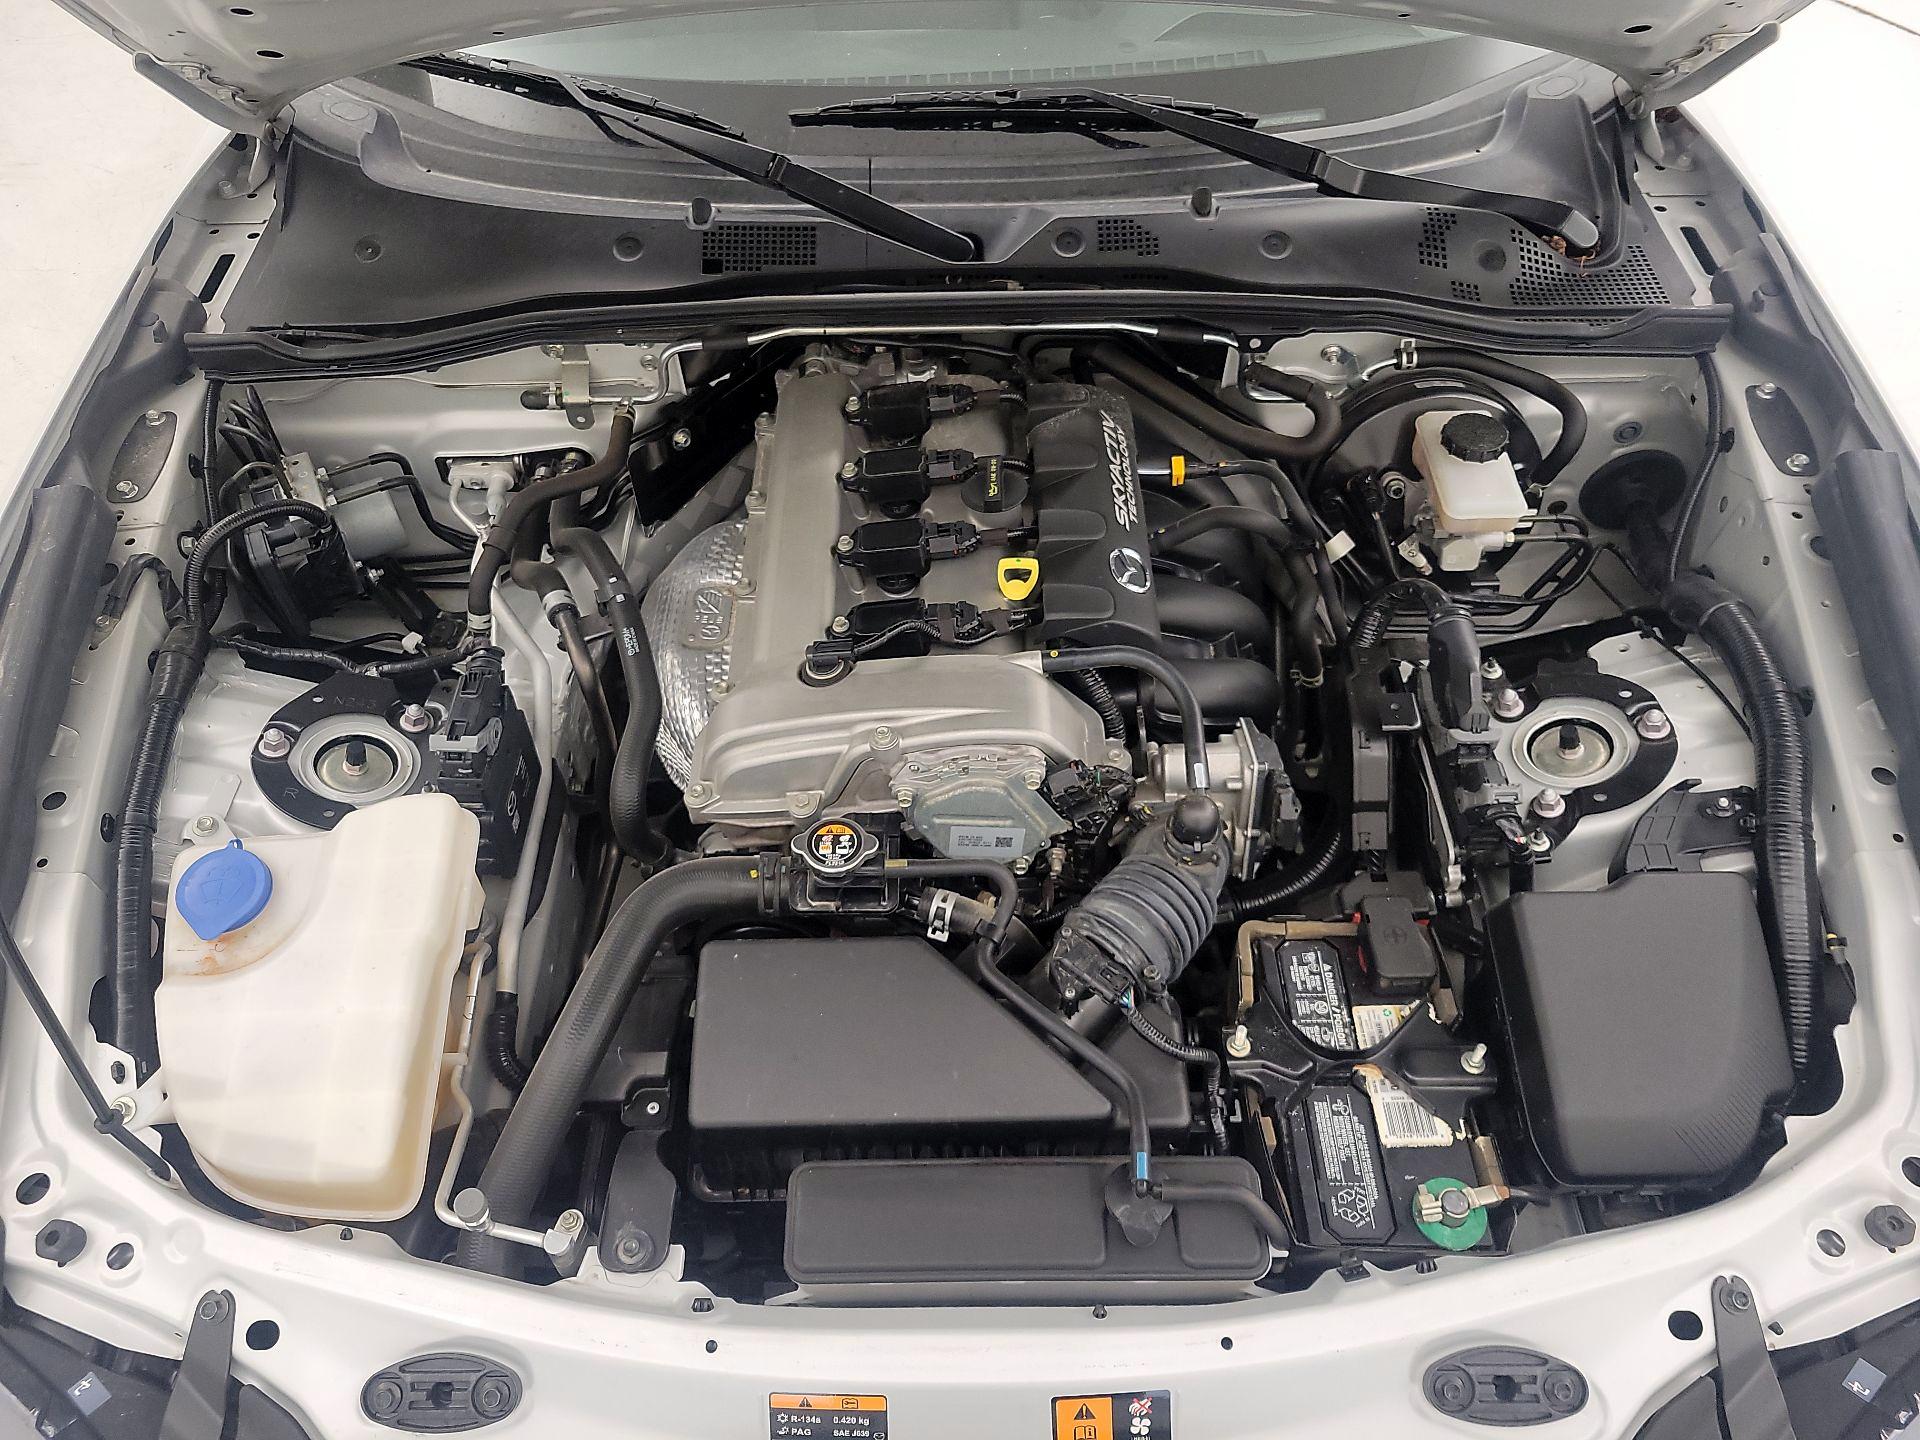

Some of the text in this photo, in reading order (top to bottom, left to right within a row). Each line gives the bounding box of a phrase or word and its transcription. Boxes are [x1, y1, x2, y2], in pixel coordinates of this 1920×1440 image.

[1100, 409, 1130, 531] SKYACTIV
[1115, 424, 1138, 524] TECHNOLOGY
[1326, 972, 1338, 1006] DANGER
[1334, 1013, 1347, 1045] POISON
[790, 1415, 870, 1426] R-134a 0.420 kg
[791, 1428, 812, 1436] PAG
[833, 1429, 850, 1437] SAE
